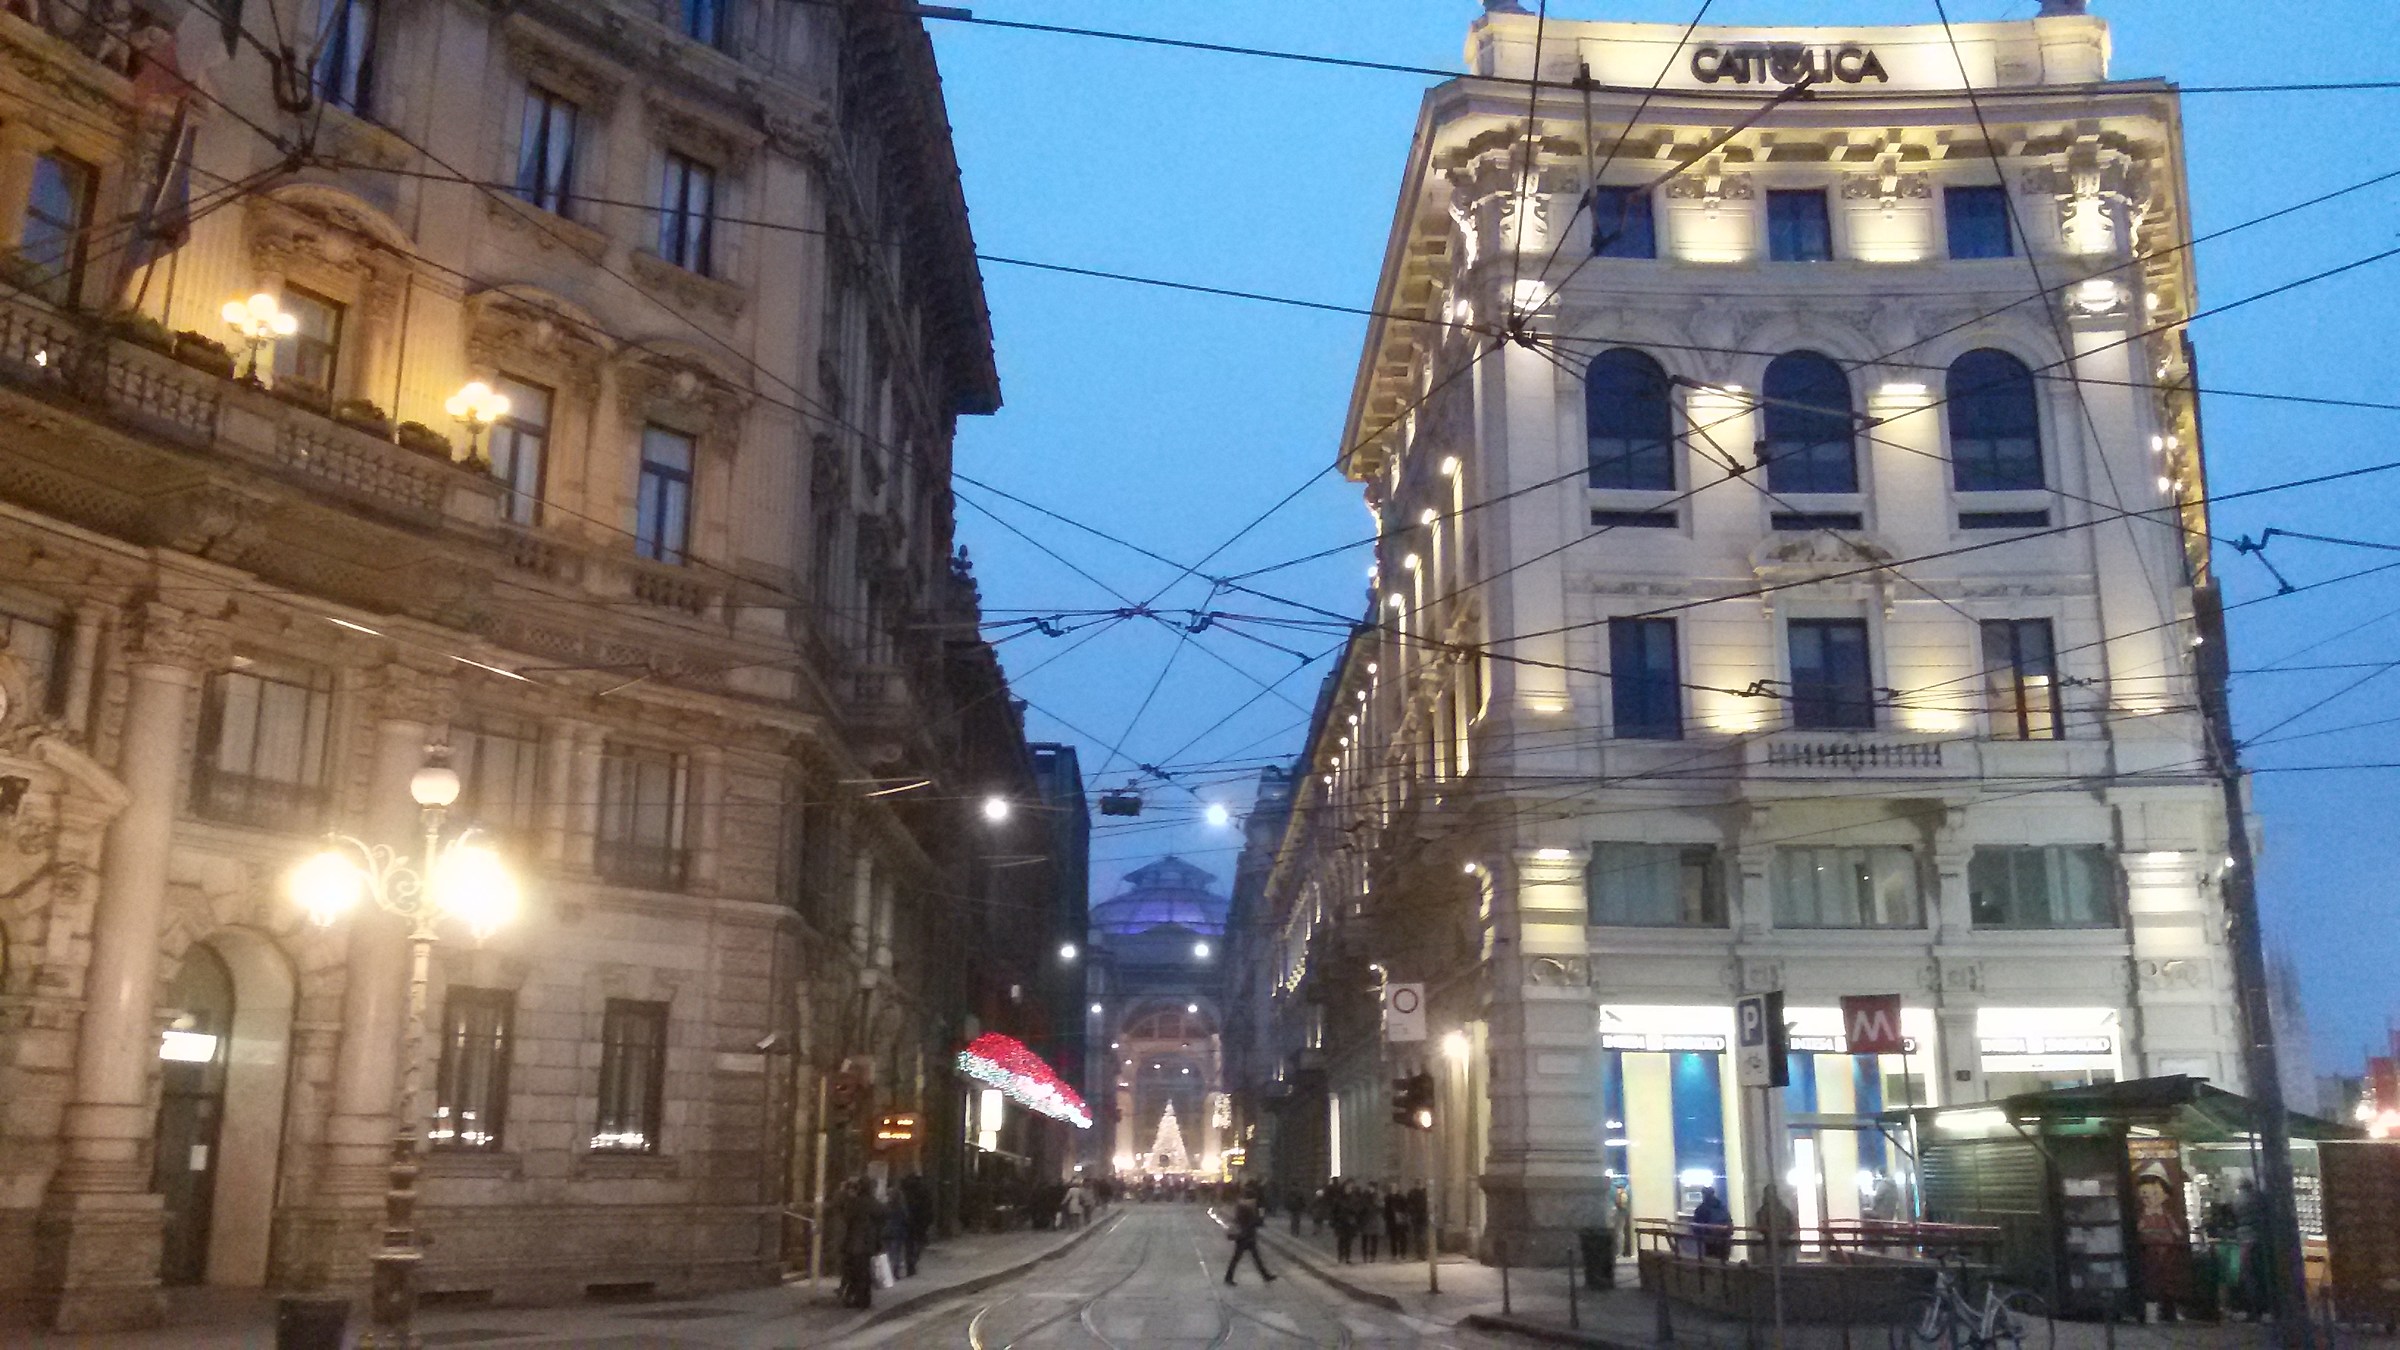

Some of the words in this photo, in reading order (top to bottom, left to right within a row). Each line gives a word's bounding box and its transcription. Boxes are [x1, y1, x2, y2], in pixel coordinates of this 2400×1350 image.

[1691, 46, 1889, 84] CATTOLICA
[1743, 1005, 1759, 1041] P
[1851, 1009, 1895, 1042] M
